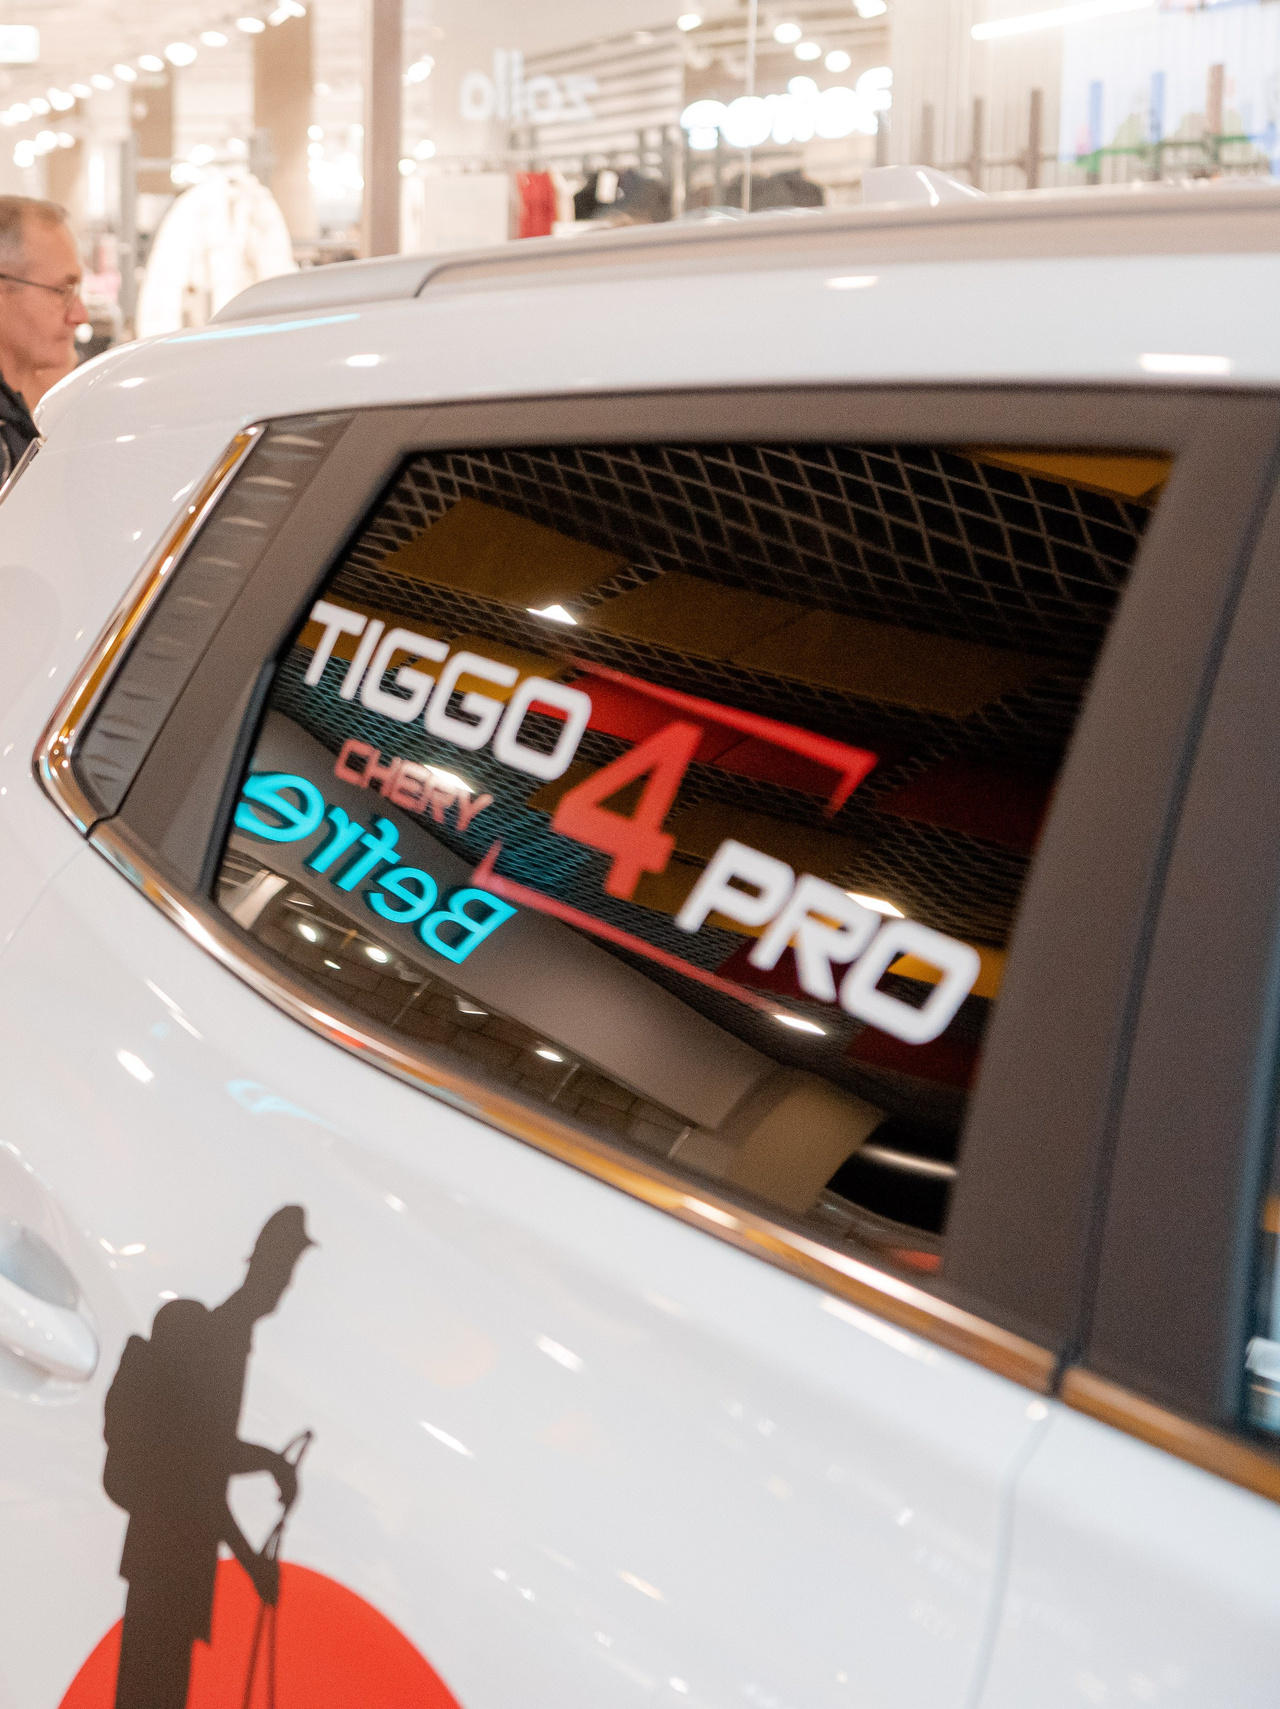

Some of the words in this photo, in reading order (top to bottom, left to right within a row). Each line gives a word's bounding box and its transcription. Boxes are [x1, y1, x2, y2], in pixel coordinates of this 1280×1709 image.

[304, 600, 592, 781] TIGGO
[550, 720, 704, 900] 4
[674, 838, 981, 1045] PRO
[334, 738, 494, 831] CHERY
